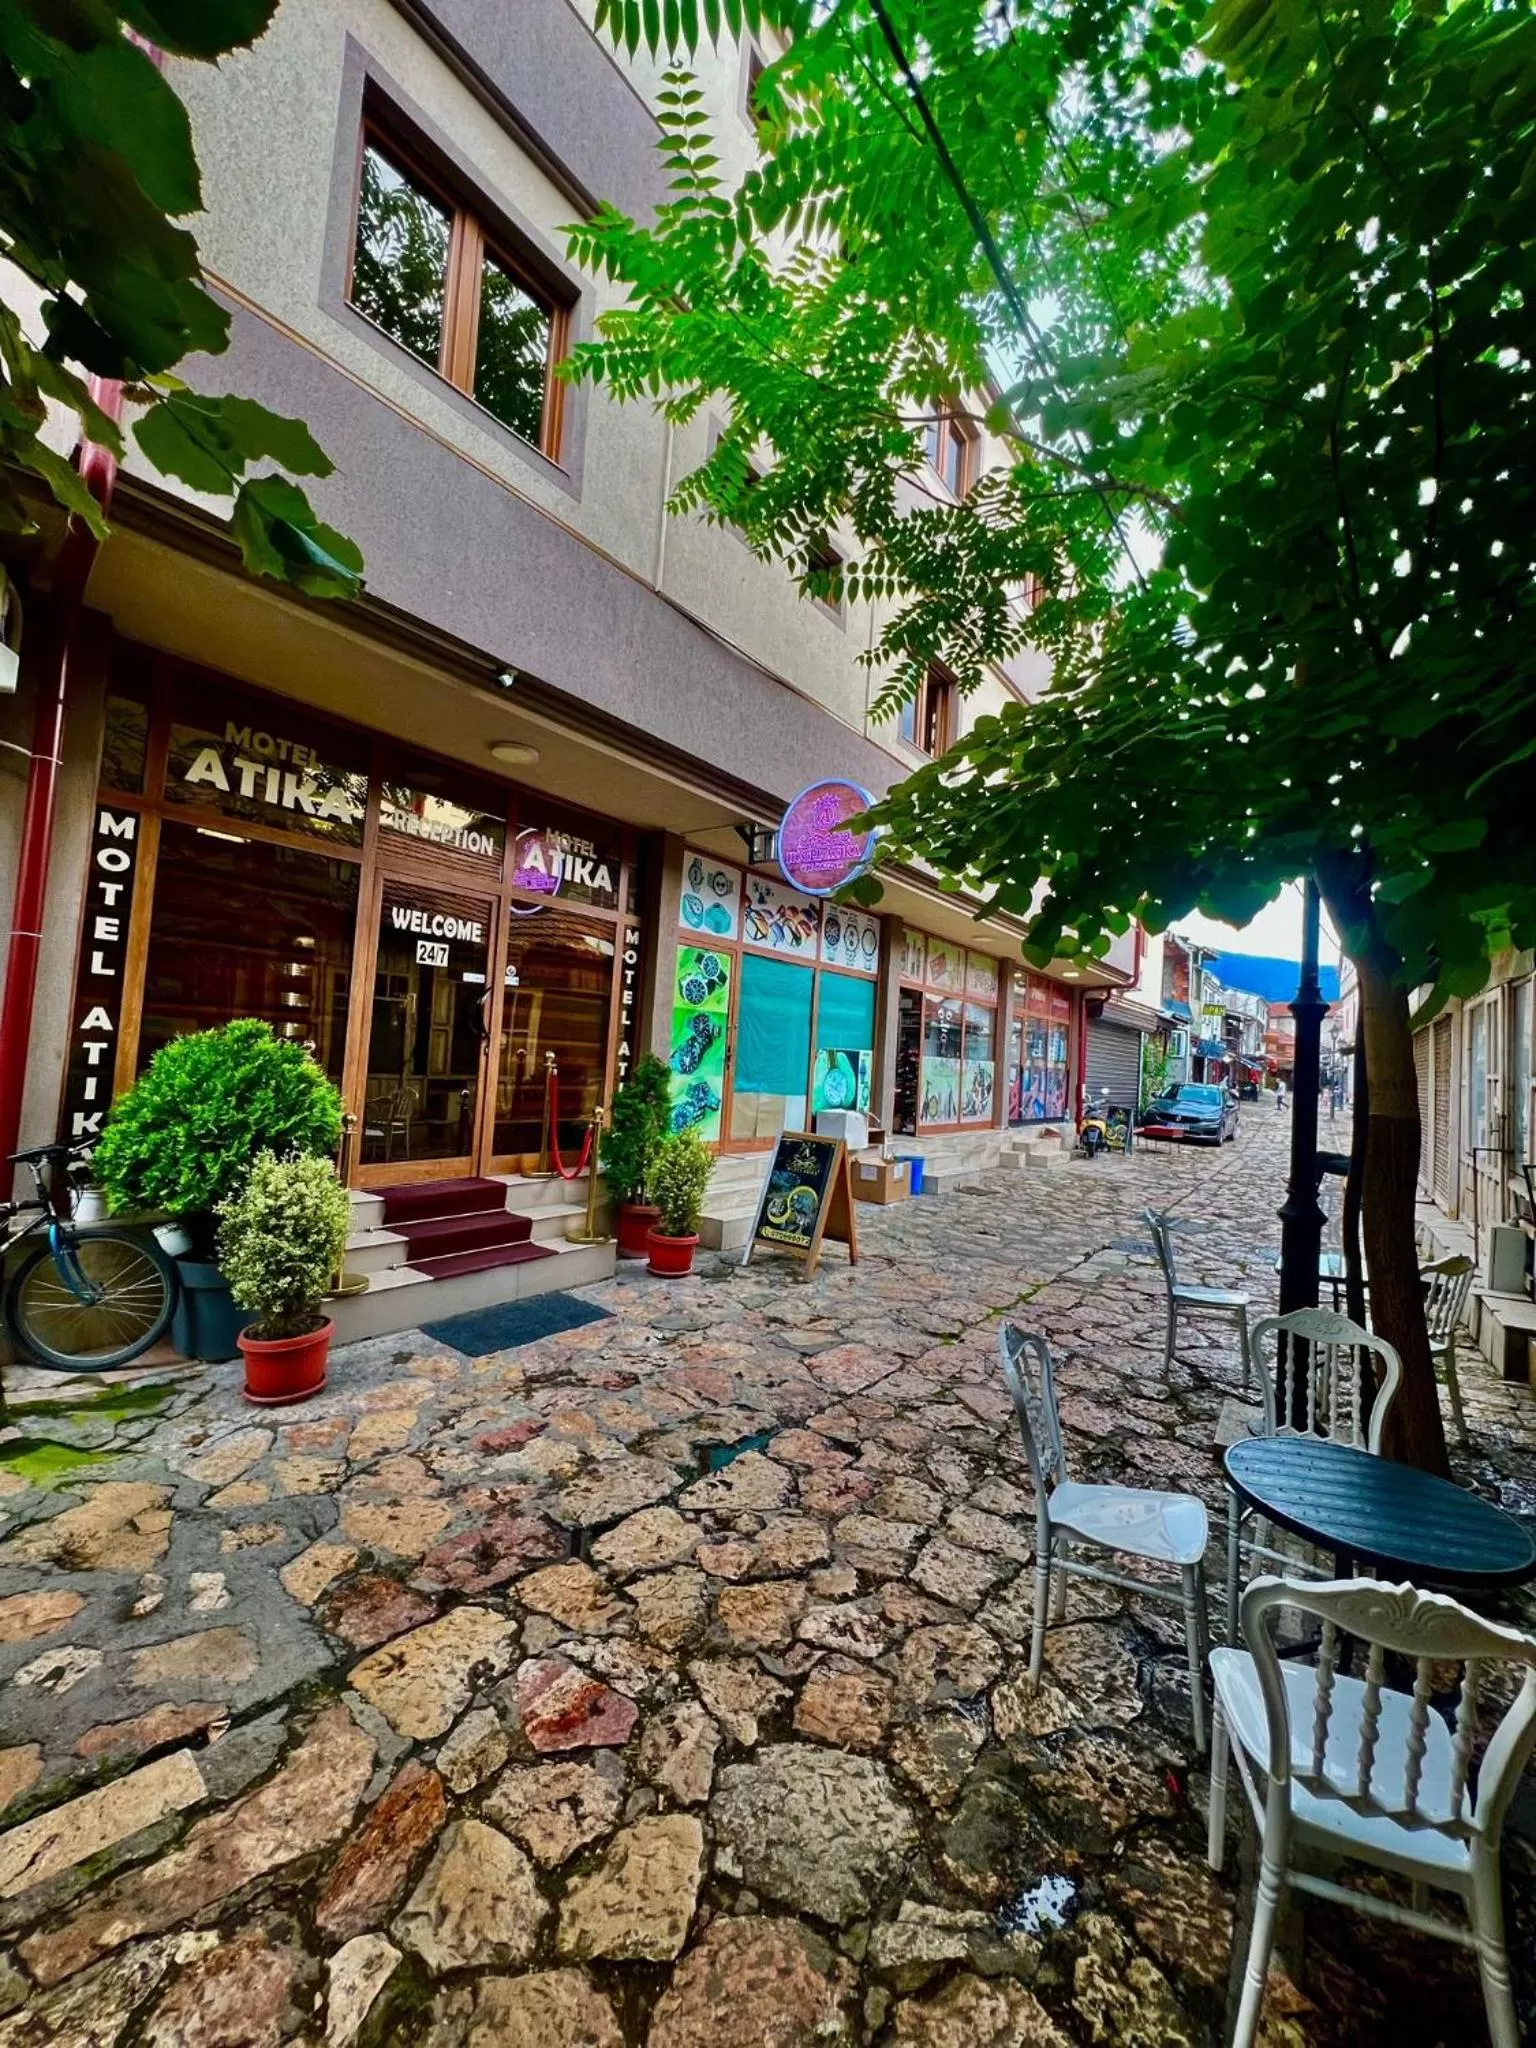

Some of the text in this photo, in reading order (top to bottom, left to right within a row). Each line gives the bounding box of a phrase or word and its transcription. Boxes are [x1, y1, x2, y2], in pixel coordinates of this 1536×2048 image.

[225, 720, 323, 772] MOTEL
[184, 747, 353, 825] ATIKA
[393, 810, 494, 857] RECEPTION
[546, 827, 597, 860] MOTEL
[90, 811, 136, 976] MOTEL
[522, 843, 613, 893] ATIKA
[391, 906, 483, 943] WELCOME
[621, 929, 640, 1025] MOTEL
